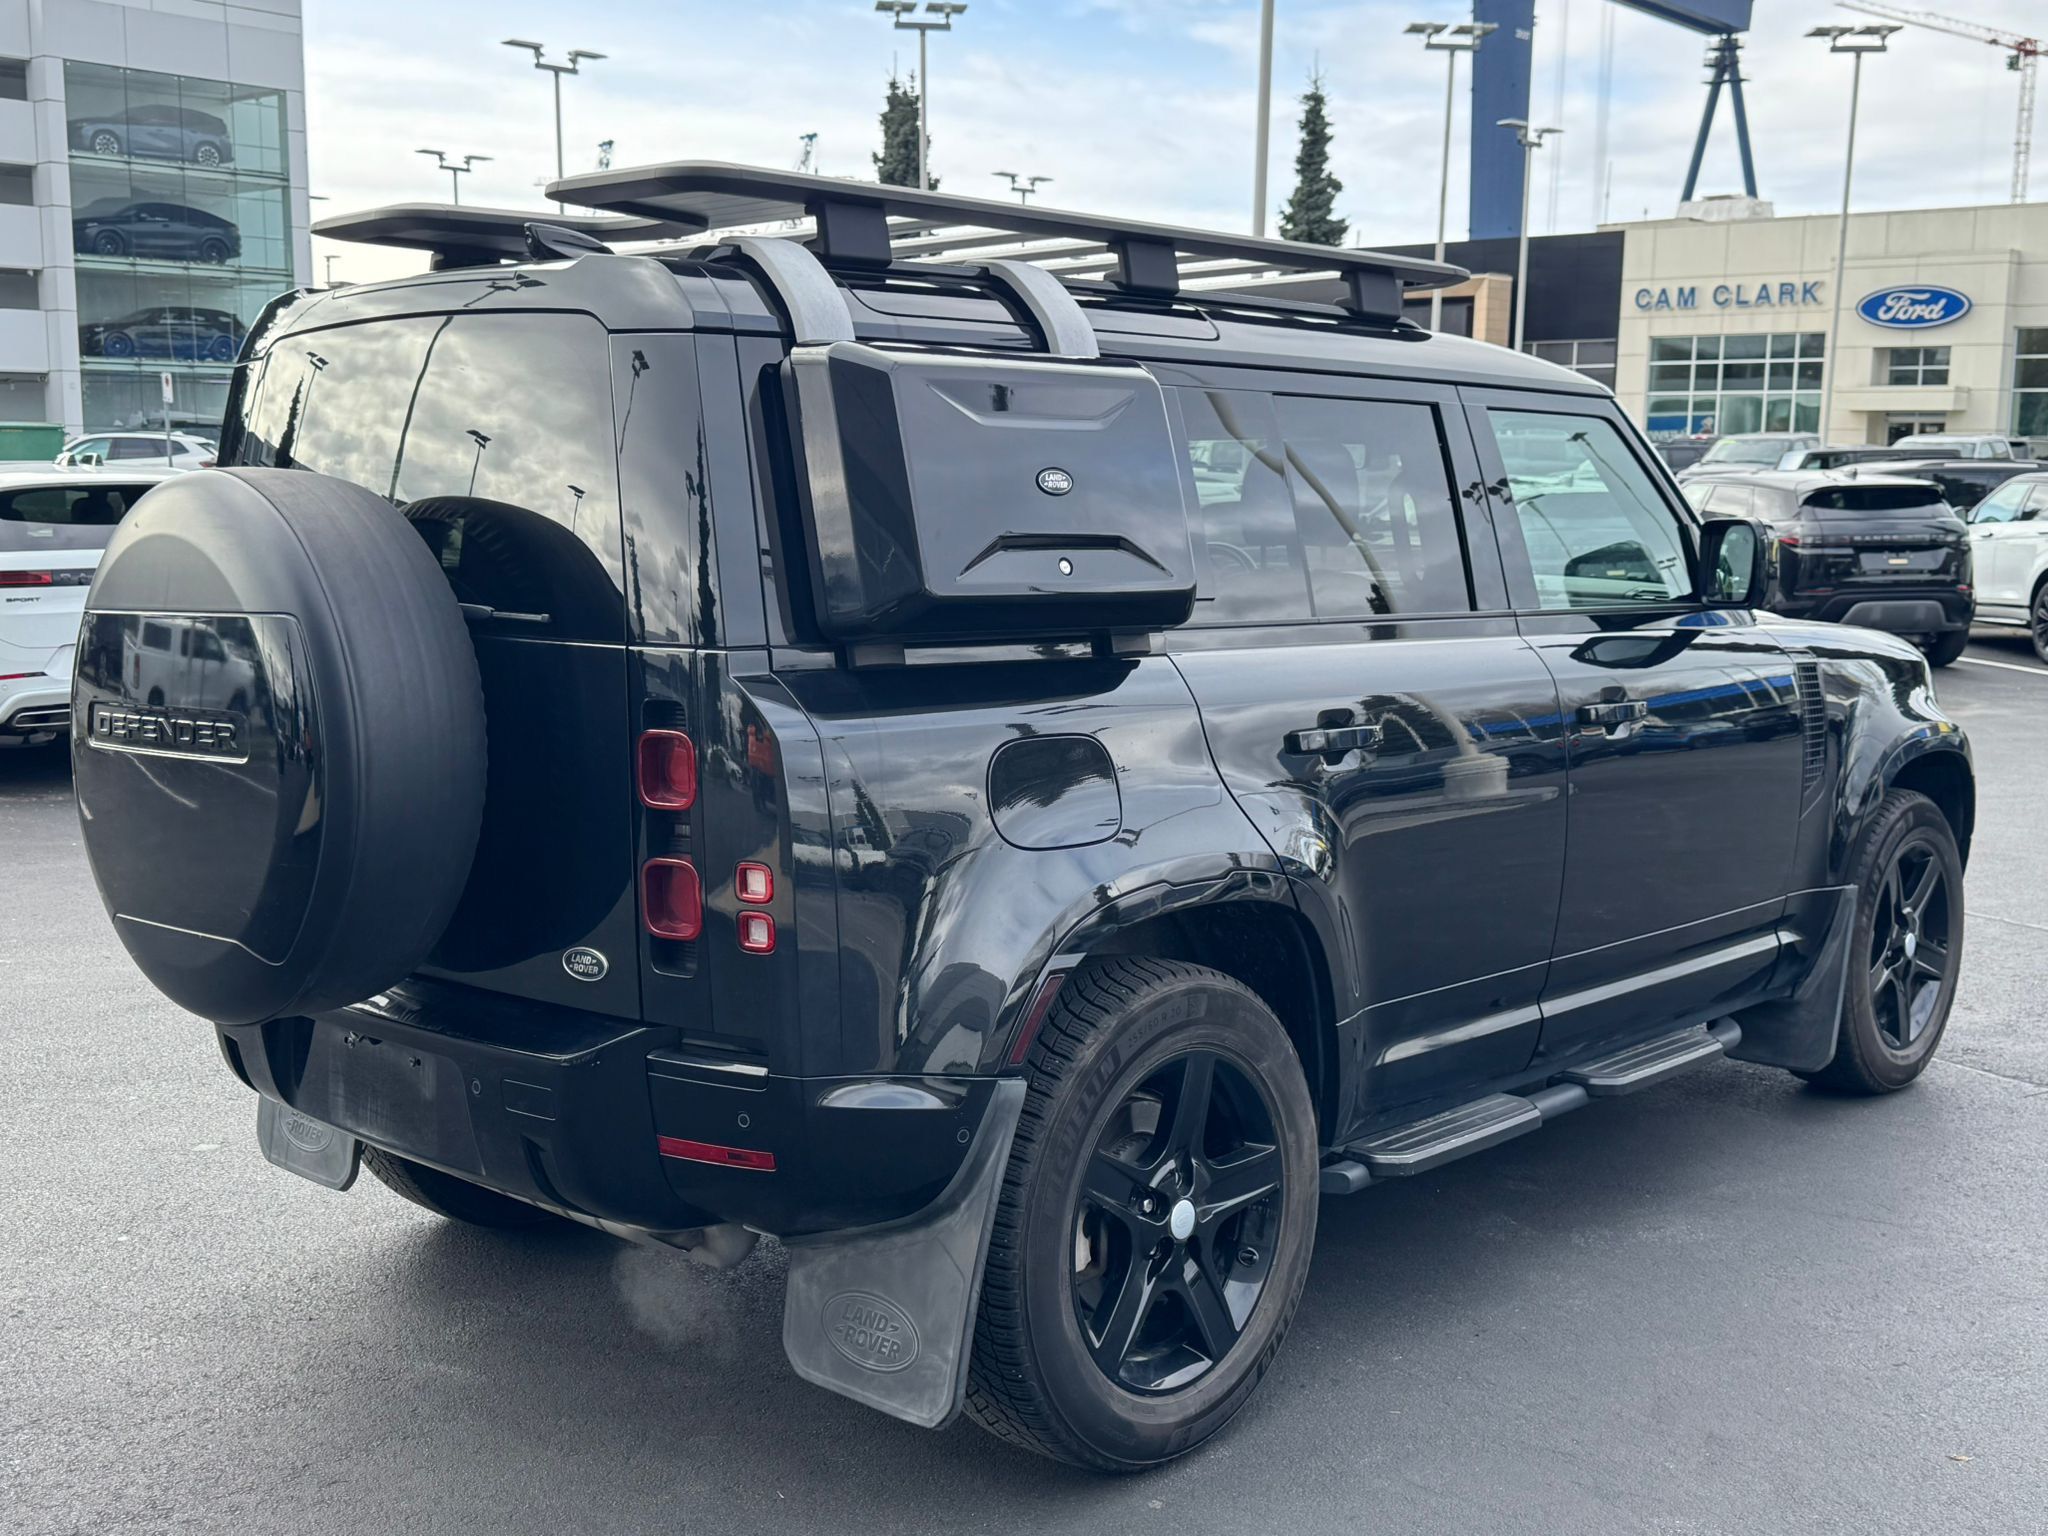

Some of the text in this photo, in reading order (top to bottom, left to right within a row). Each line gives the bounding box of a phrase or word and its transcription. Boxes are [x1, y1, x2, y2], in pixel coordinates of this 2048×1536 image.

[1634, 281, 1824, 311] CAM CLARK
[1877, 291, 1948, 321] Ford
[1045, 473, 1063, 481] LAND
[1047, 481, 1069, 489] ROVER
[98, 711, 237, 750] DEFENDER
[571, 953, 592, 965] LAND
[573, 963, 599, 975] ROVER
[290, 1119, 325, 1141] ROVER
[842, 1303, 889, 1333] LAND
[844, 1324, 901, 1360] ROVER
